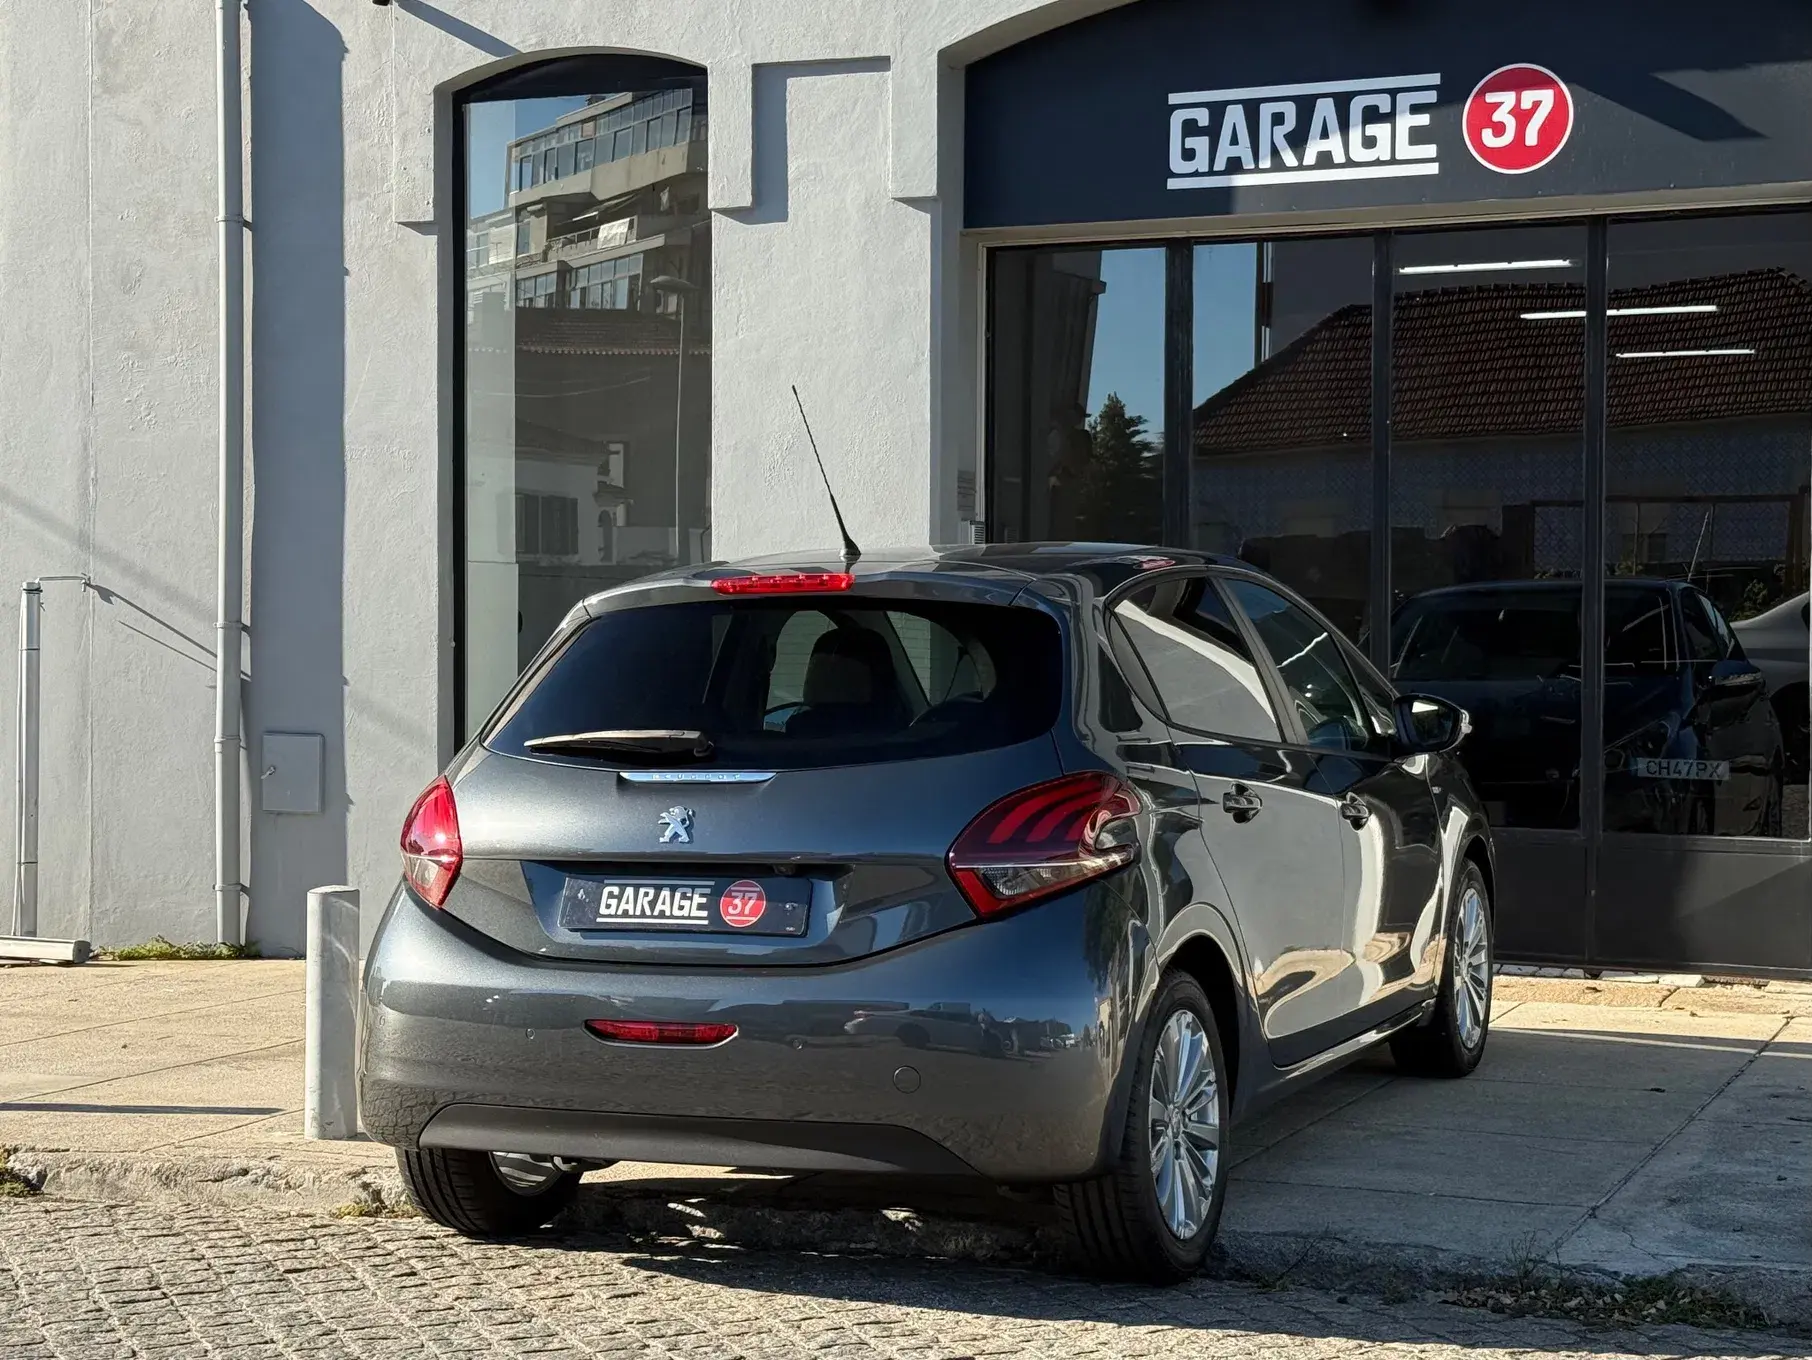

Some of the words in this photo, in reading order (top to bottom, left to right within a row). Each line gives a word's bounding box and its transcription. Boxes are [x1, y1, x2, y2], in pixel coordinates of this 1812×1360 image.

[1169, 90, 1438, 174] GARAGE
[1481, 89, 1555, 148] 37
[599, 886, 711, 917] GARAGE
[728, 892, 756, 915] 37
